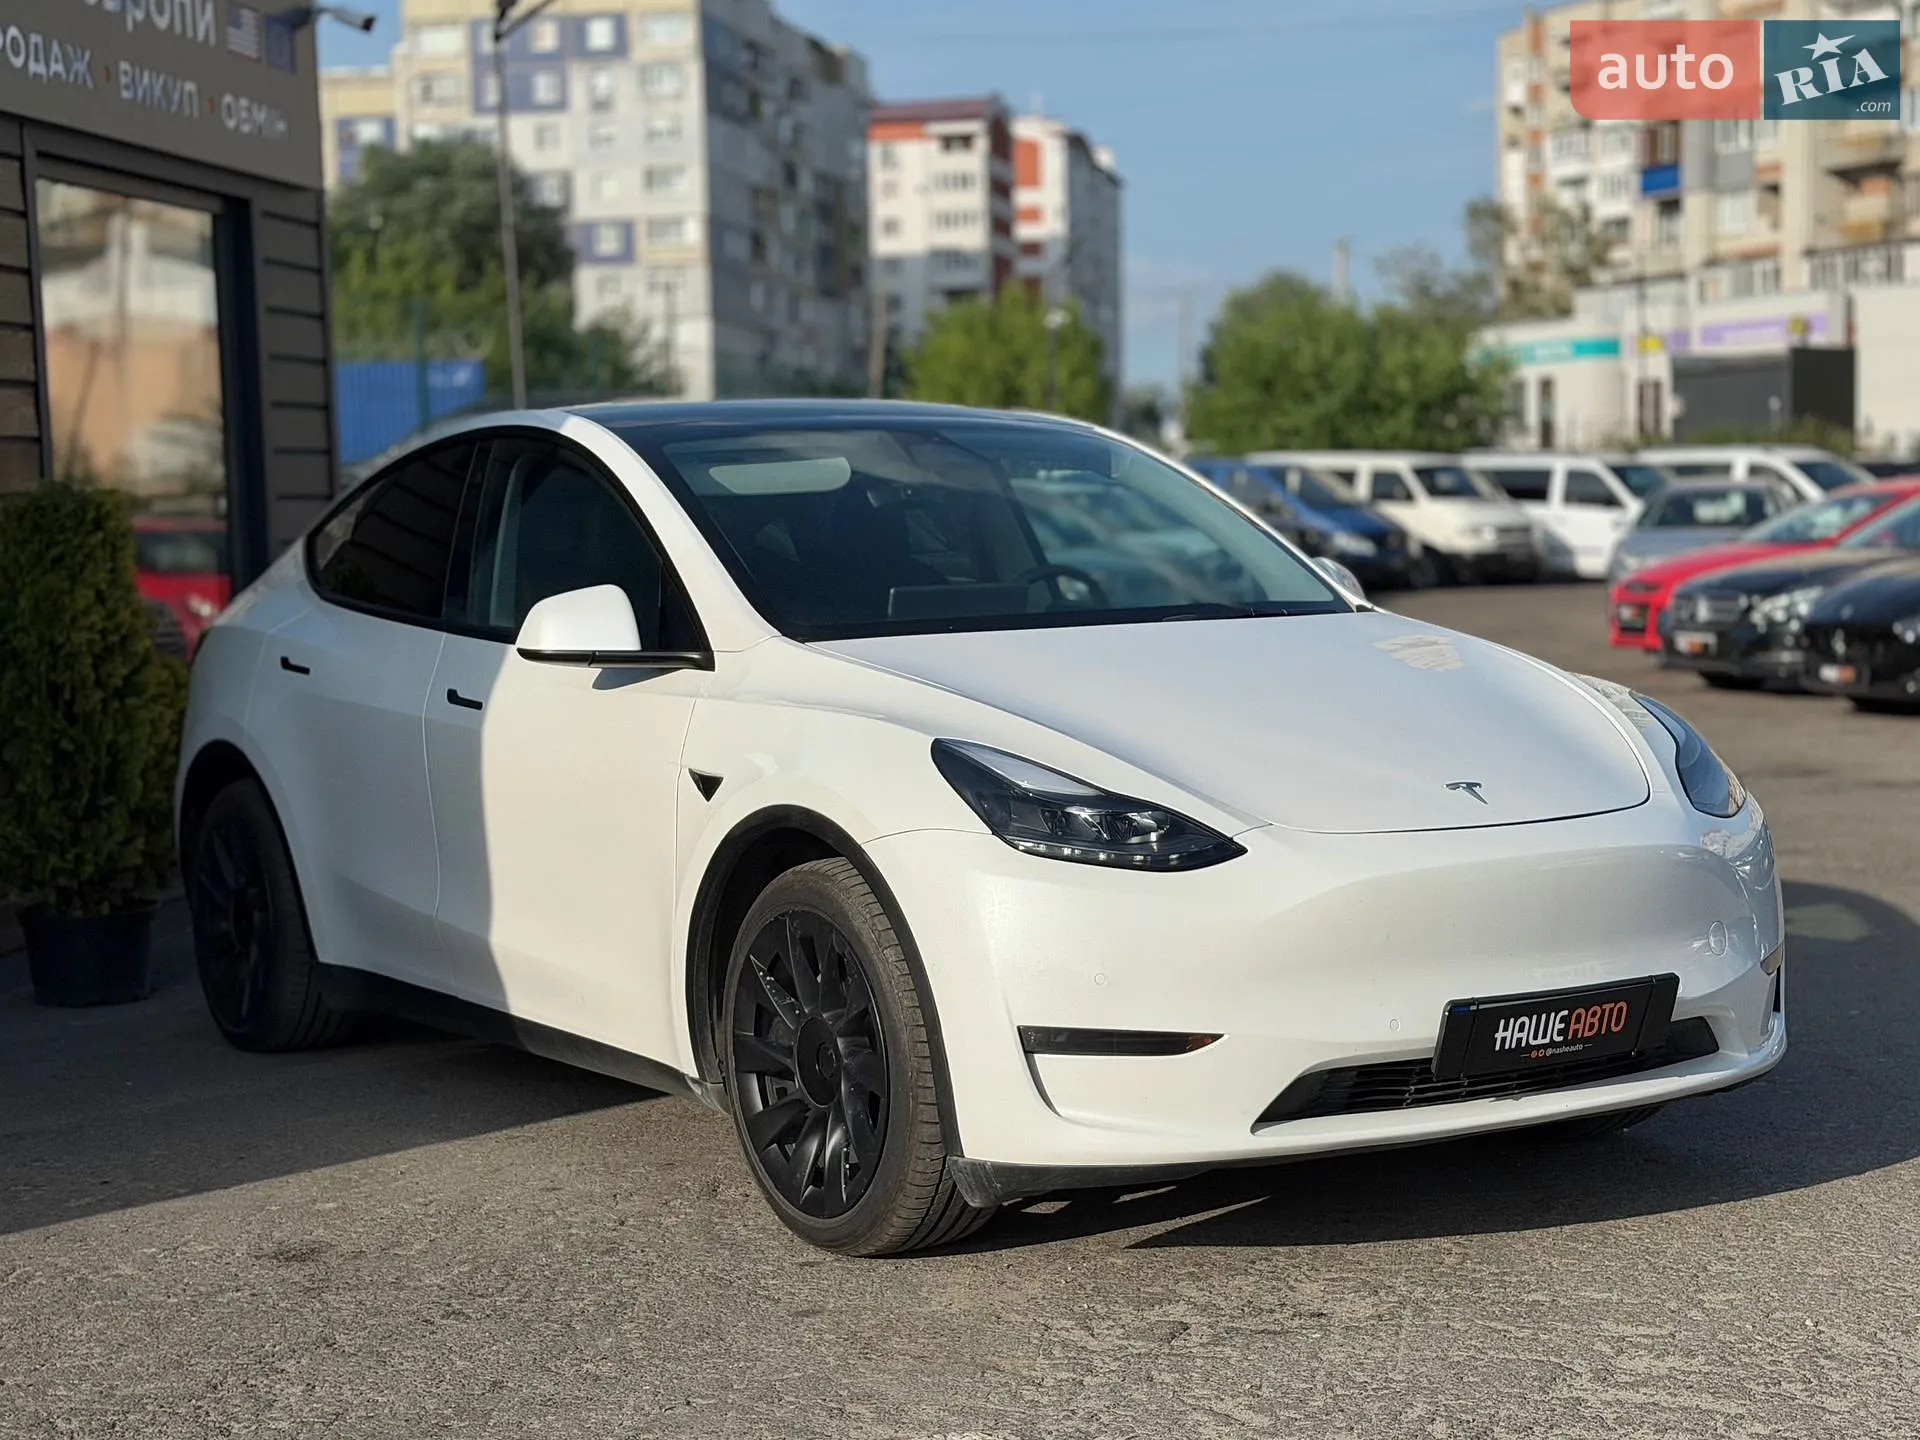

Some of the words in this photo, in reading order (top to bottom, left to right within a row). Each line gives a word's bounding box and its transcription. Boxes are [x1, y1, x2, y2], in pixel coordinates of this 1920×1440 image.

[84, 0, 216, 47] ропи
[0, 25, 94, 90] ОДАЖ
[119, 60, 199, 119] ВИКУП
